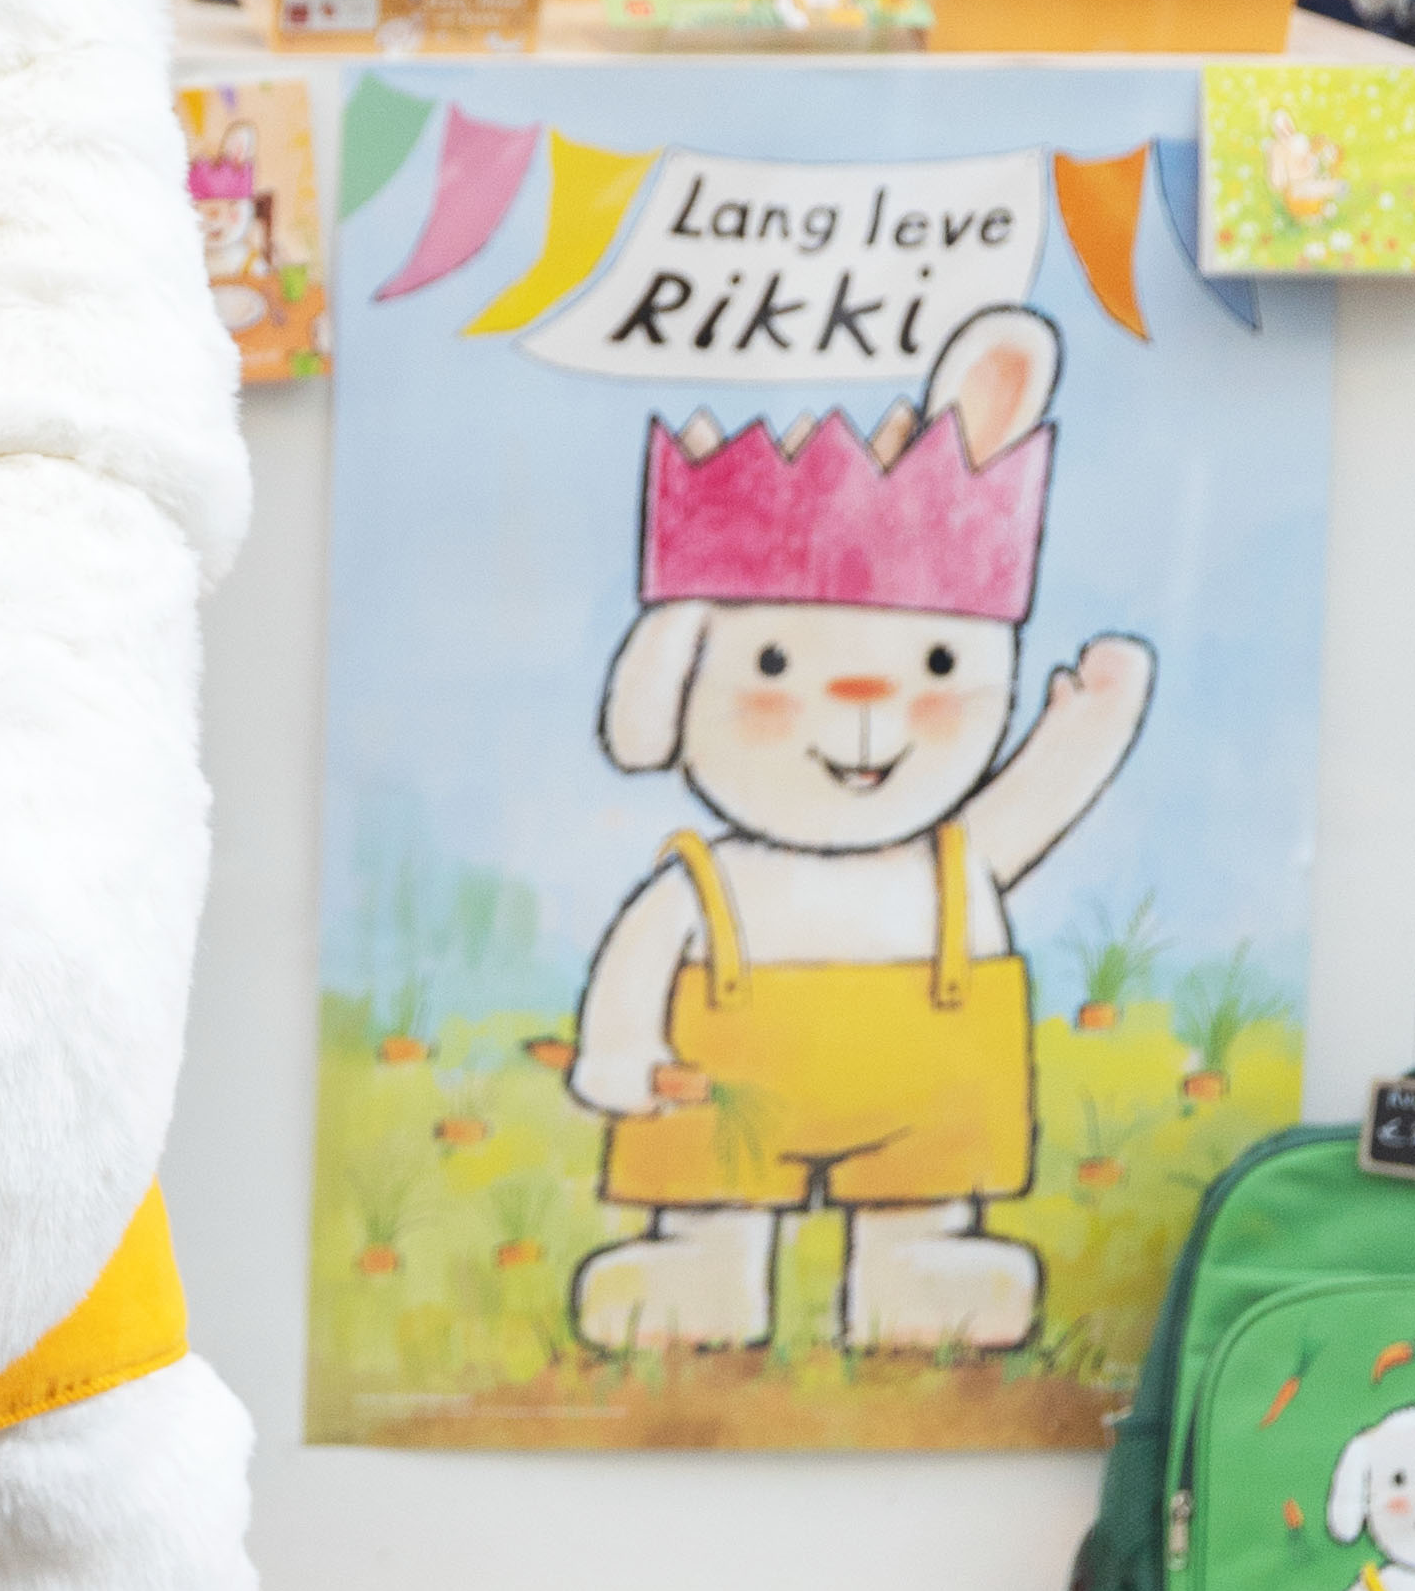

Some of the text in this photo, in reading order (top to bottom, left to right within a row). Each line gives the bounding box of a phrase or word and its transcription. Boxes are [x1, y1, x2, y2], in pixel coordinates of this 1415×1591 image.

[670, 174, 1017, 254] Lang leve
[609, 264, 934, 356] Rikki
